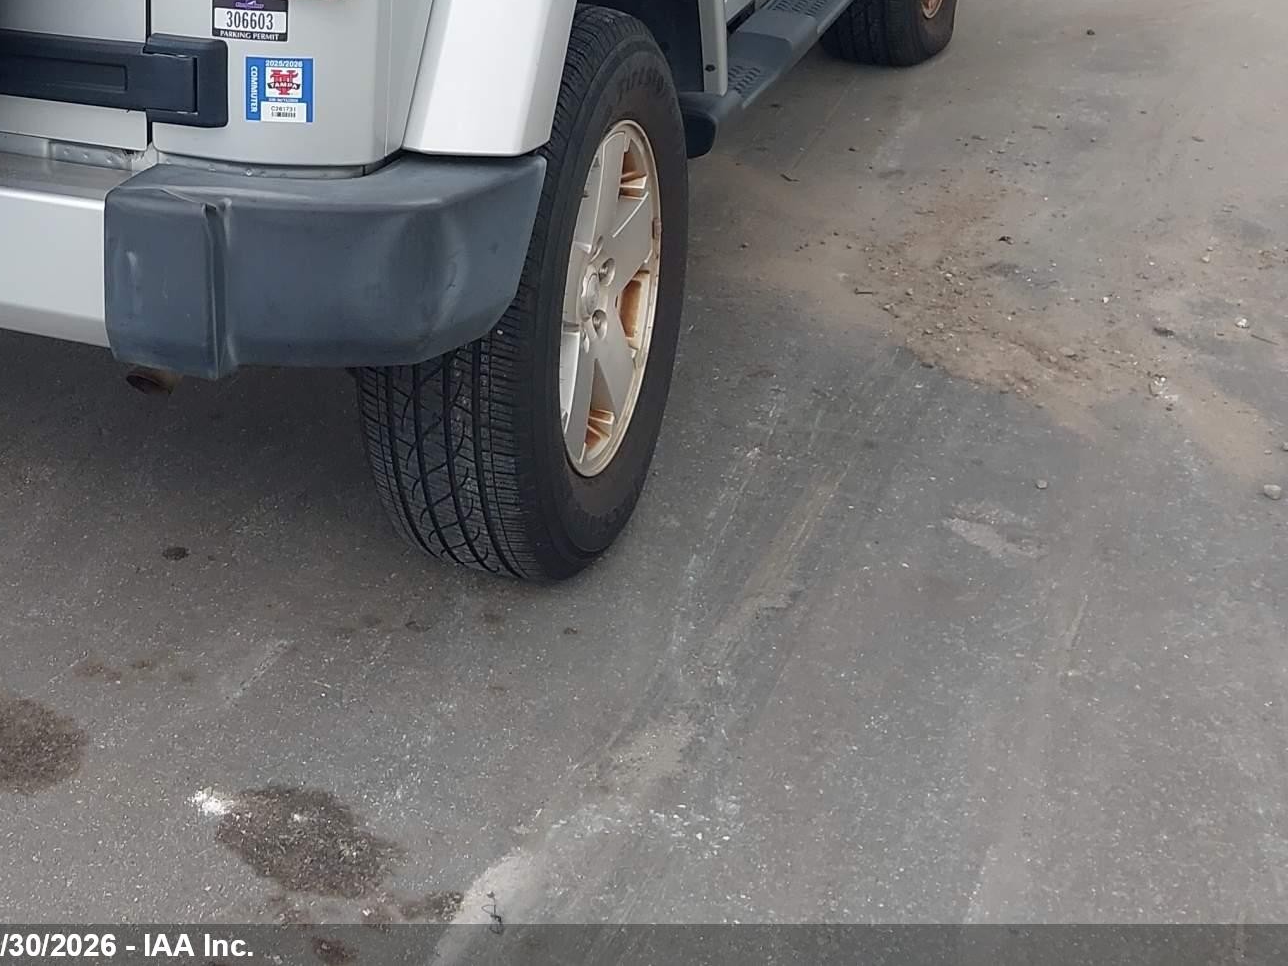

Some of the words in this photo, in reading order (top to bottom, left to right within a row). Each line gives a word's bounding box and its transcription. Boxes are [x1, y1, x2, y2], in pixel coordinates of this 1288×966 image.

[226, 10, 273, 30] 306603
[220, 29, 251, 39] PARKING
[252, 32, 280, 41] PERMIT
[250, 65, 258, 113] COMMUTER
[268, 81, 298, 90] TAMPA
